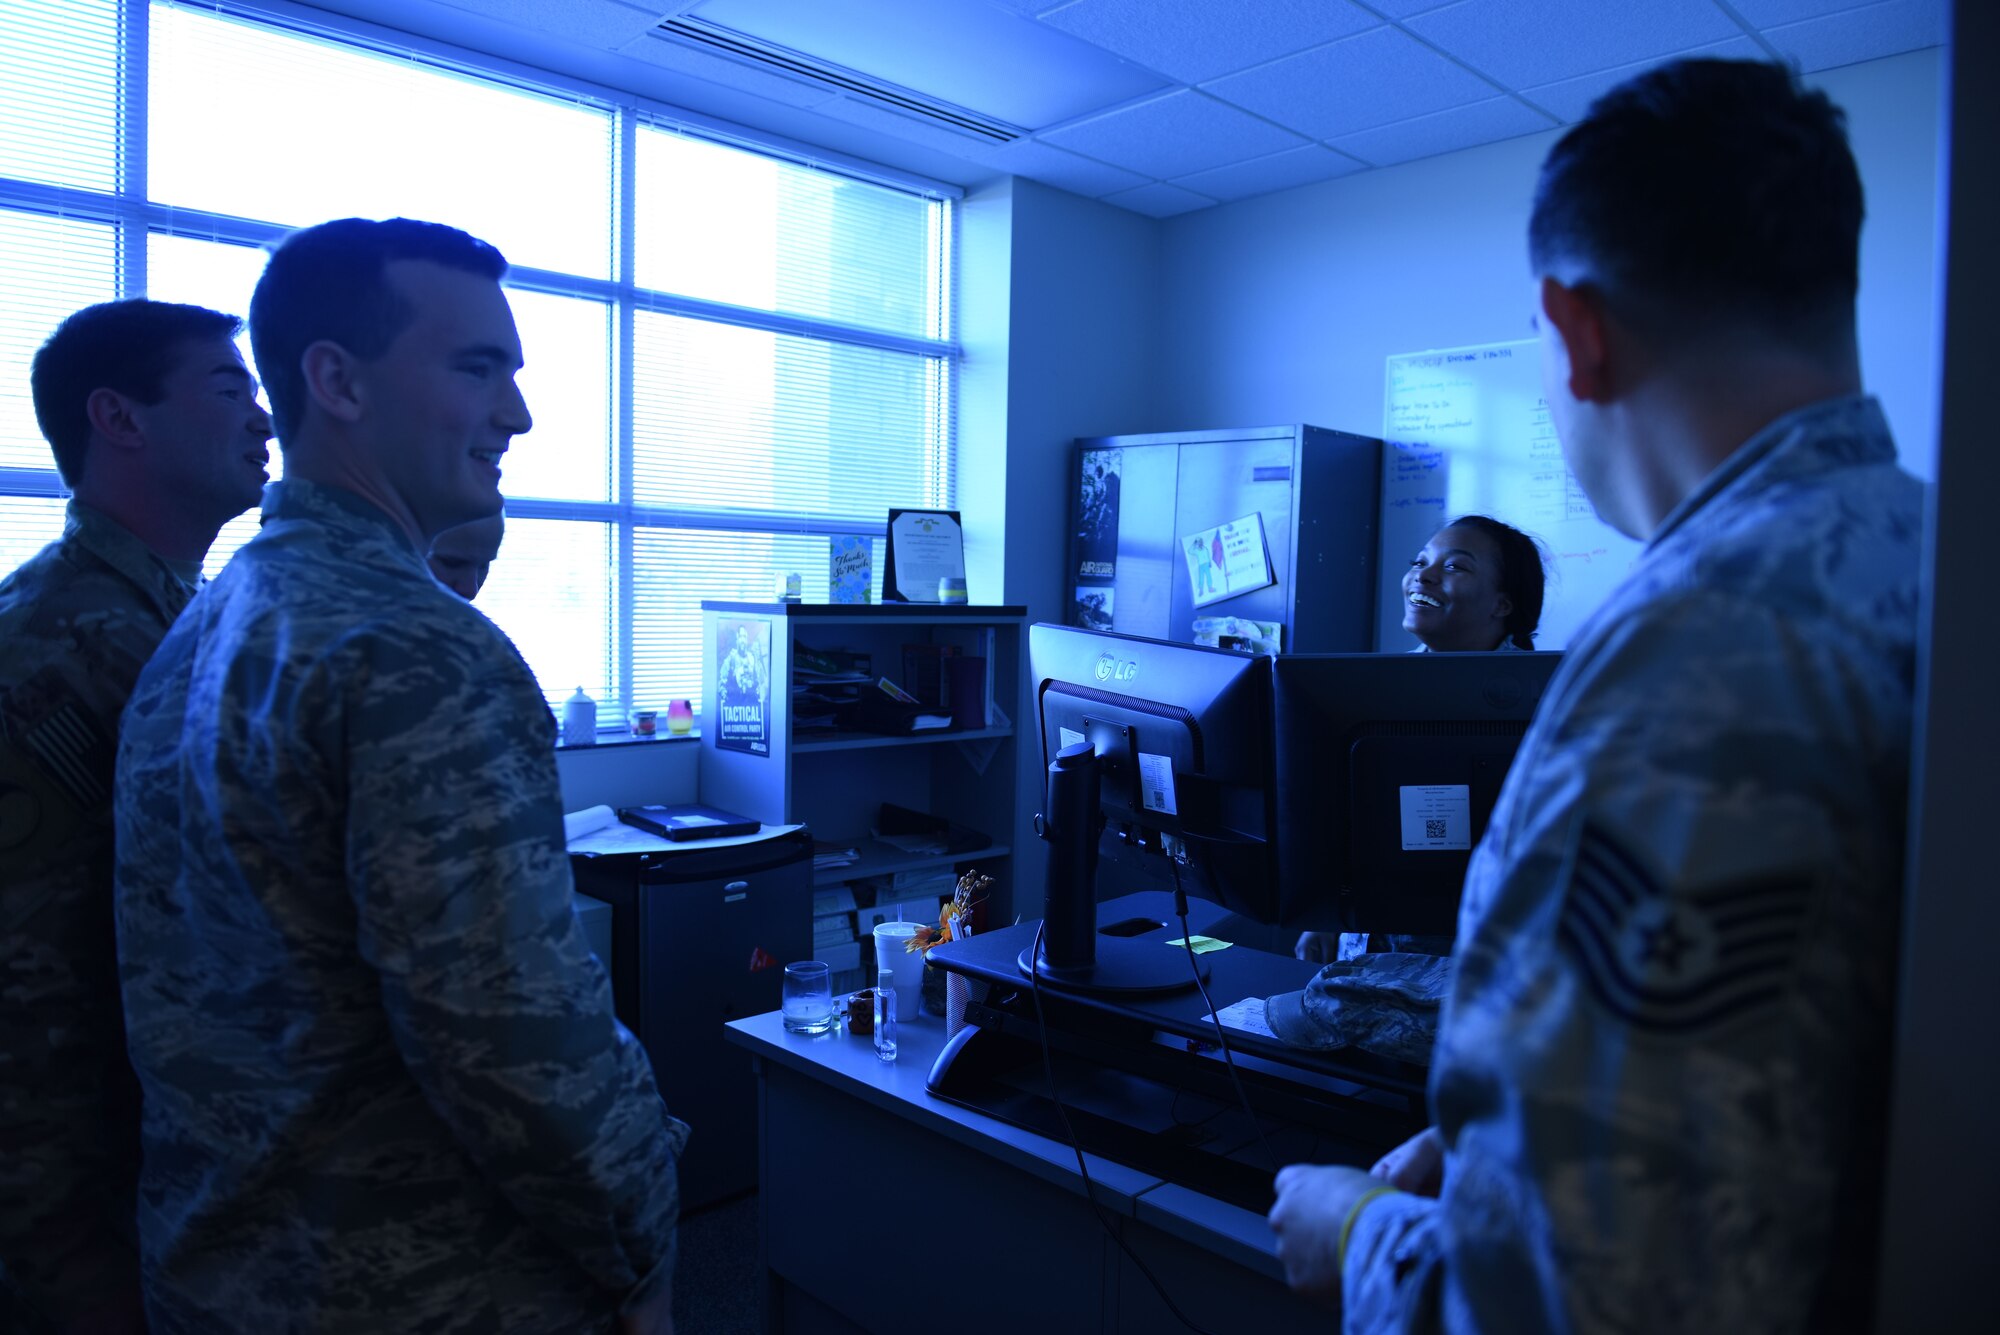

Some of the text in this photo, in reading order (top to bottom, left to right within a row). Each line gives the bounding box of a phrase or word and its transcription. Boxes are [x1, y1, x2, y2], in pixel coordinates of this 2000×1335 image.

[835, 551, 865, 566] Thanks
[833, 559, 869, 578] So Much
[1080, 560, 1095, 573] AIR
[1114, 659, 1137, 681] LG
[723, 706, 761, 722] TACTICAL
[731, 724, 749, 733] CONTROL
